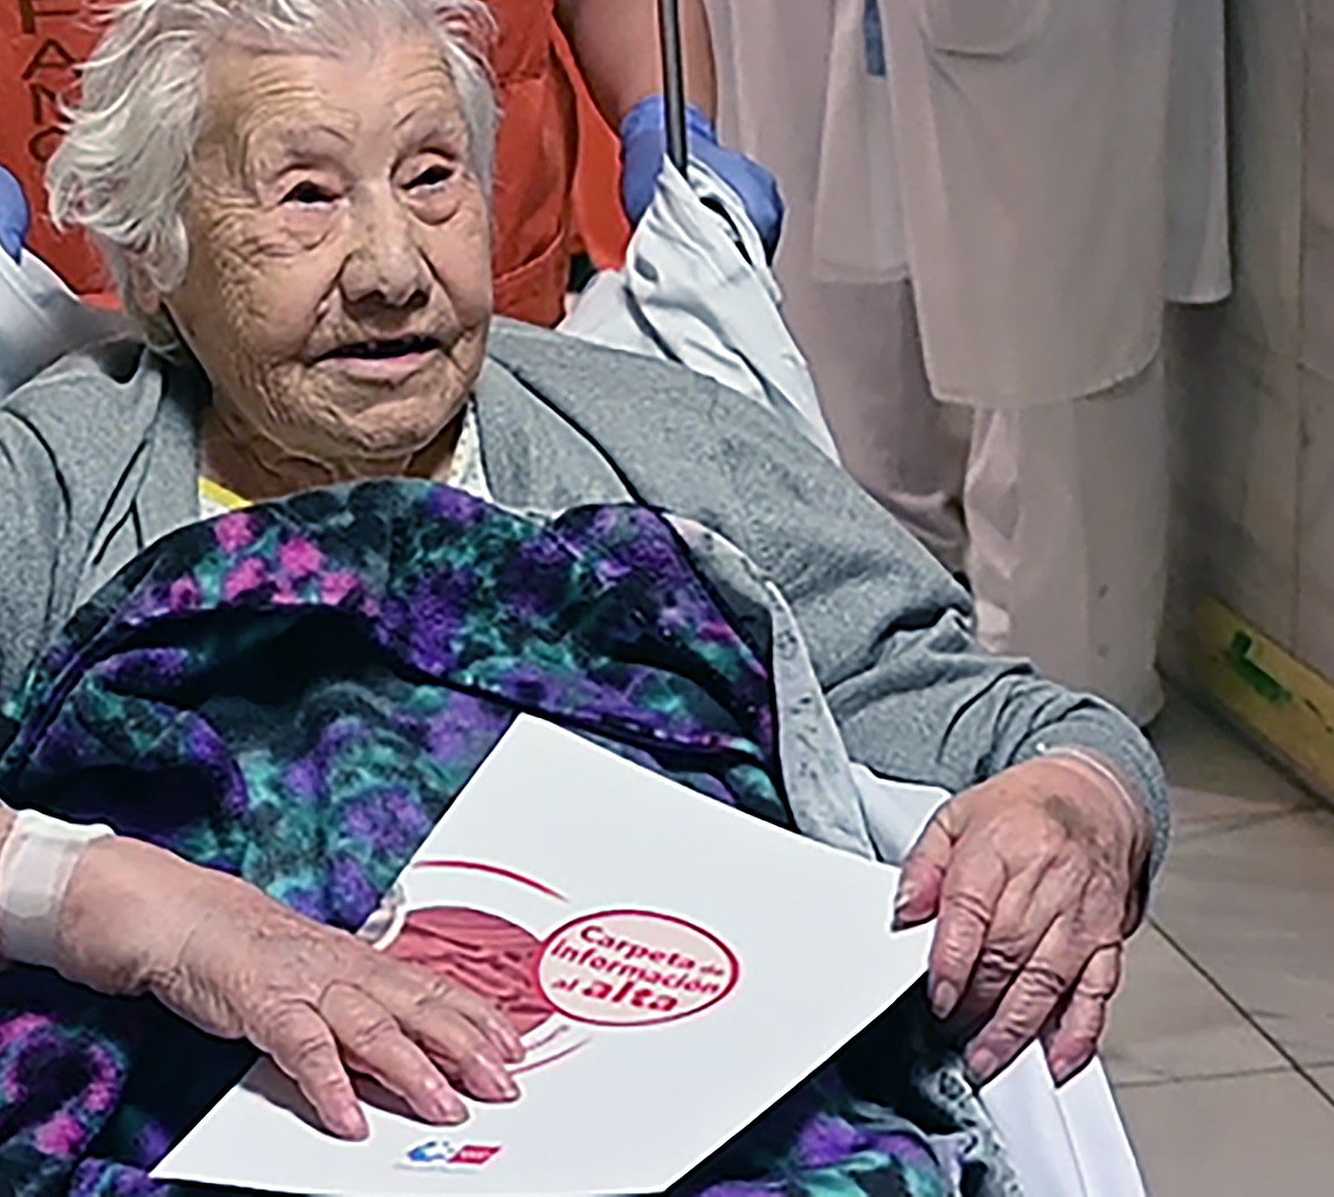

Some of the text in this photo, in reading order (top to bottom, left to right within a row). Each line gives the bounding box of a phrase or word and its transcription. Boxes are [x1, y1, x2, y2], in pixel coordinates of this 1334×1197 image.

[580, 924, 696, 969] Carpeta
[551, 977, 679, 1013] al alta
